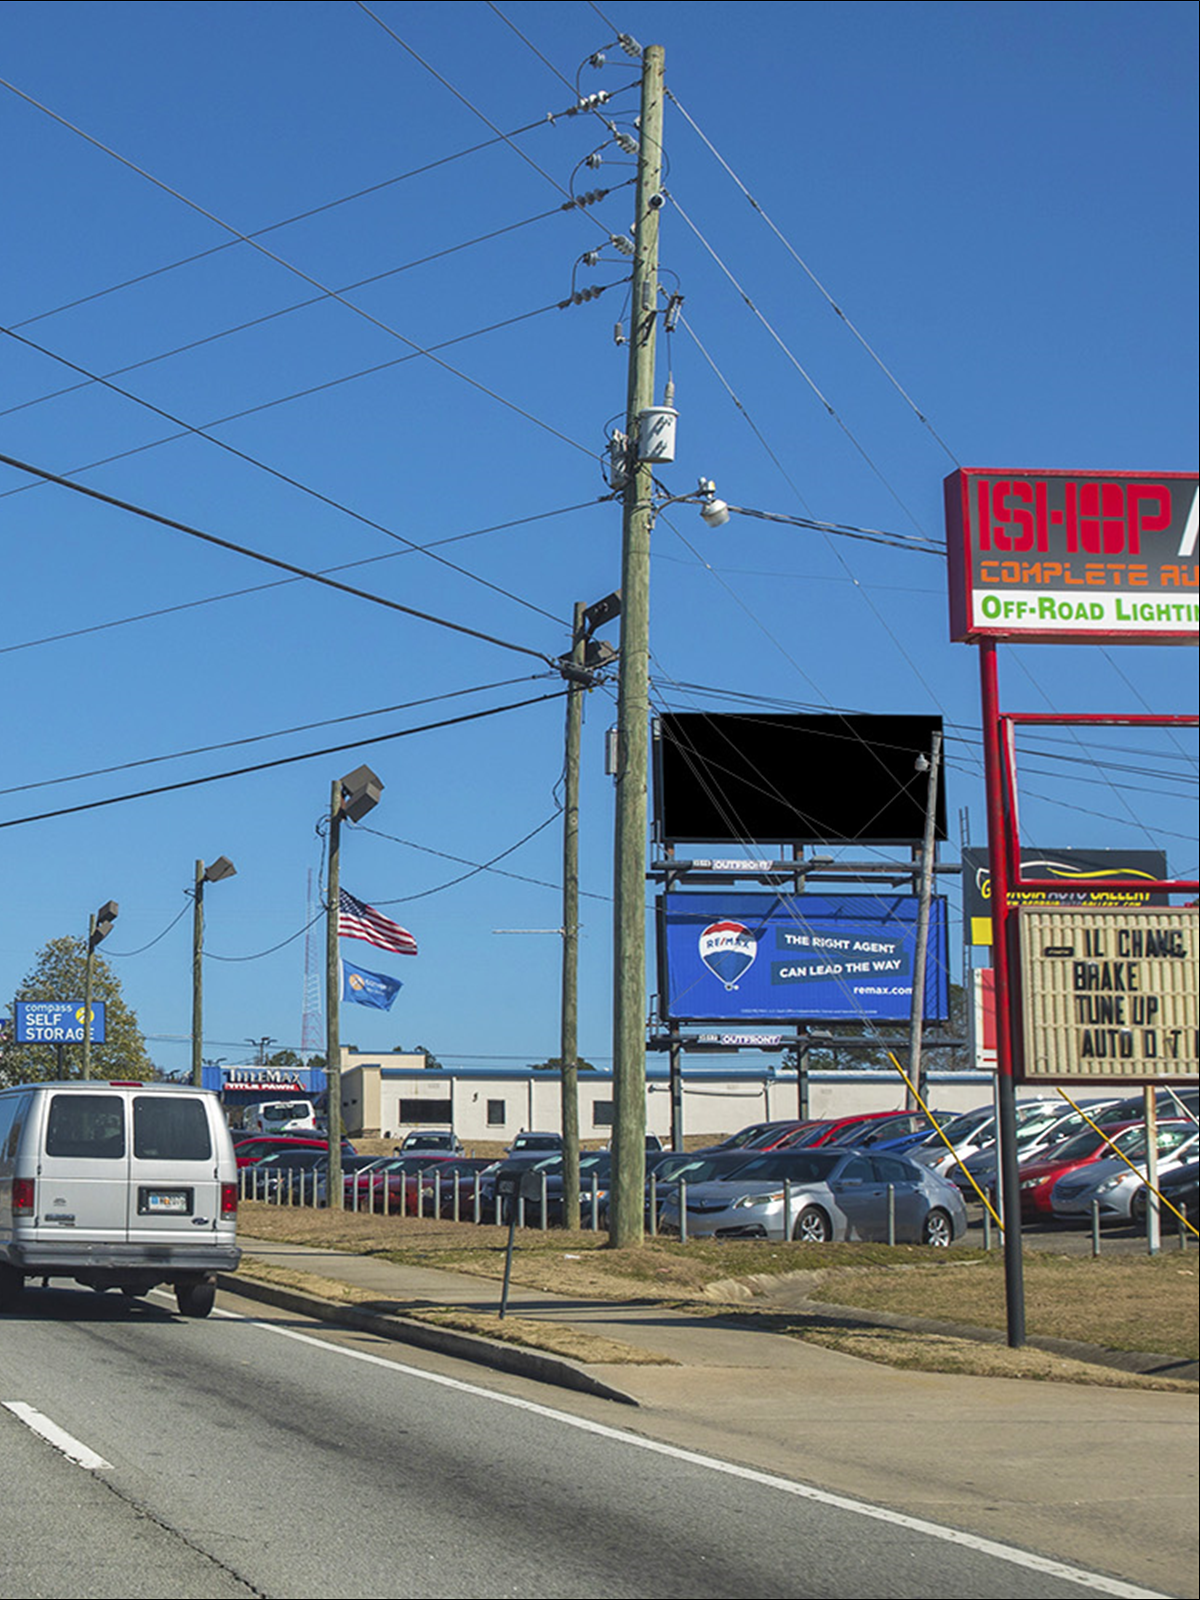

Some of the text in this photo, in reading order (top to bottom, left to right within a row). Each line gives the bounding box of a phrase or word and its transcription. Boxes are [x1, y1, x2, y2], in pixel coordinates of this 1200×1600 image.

[980, 560, 1149, 586] COMPLETE
[706, 937, 750, 949] RE/MAX
[784, 934, 895, 954] THE RIGHT AGENT
[779, 959, 901, 978] CAN LEAD THE WAY
[1073, 961, 1138, 991] BRAKE
[25, 1004, 73, 1014] compass
[1075, 994, 1159, 1025] TUNE UP
[25, 1013, 62, 1026] SELF
[1082, 1029, 1133, 1058] AUTO
